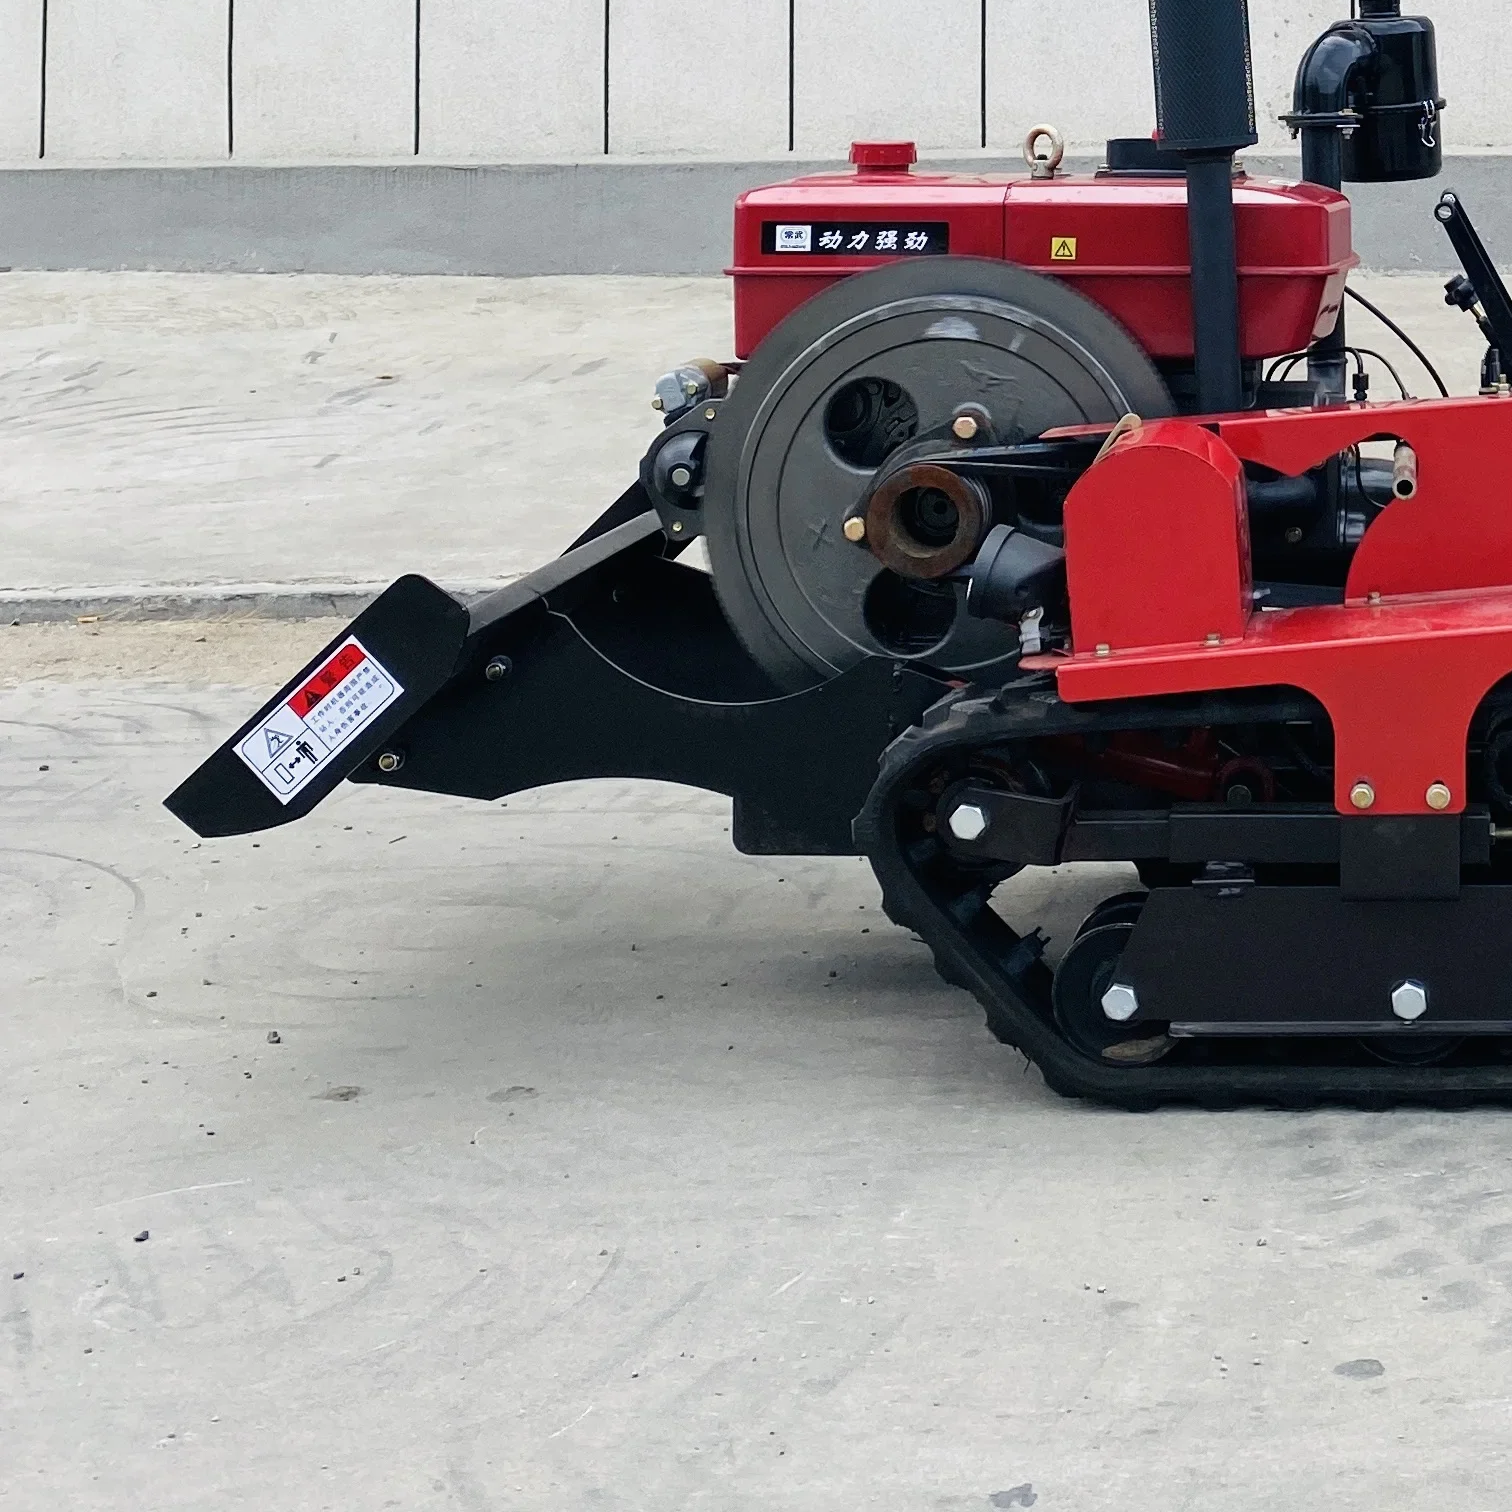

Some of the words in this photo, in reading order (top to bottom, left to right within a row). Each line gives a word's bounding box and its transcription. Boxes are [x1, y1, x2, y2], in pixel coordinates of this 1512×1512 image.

[818, 230, 929, 251] 动力强劲
[320, 653, 355, 689] 警告
